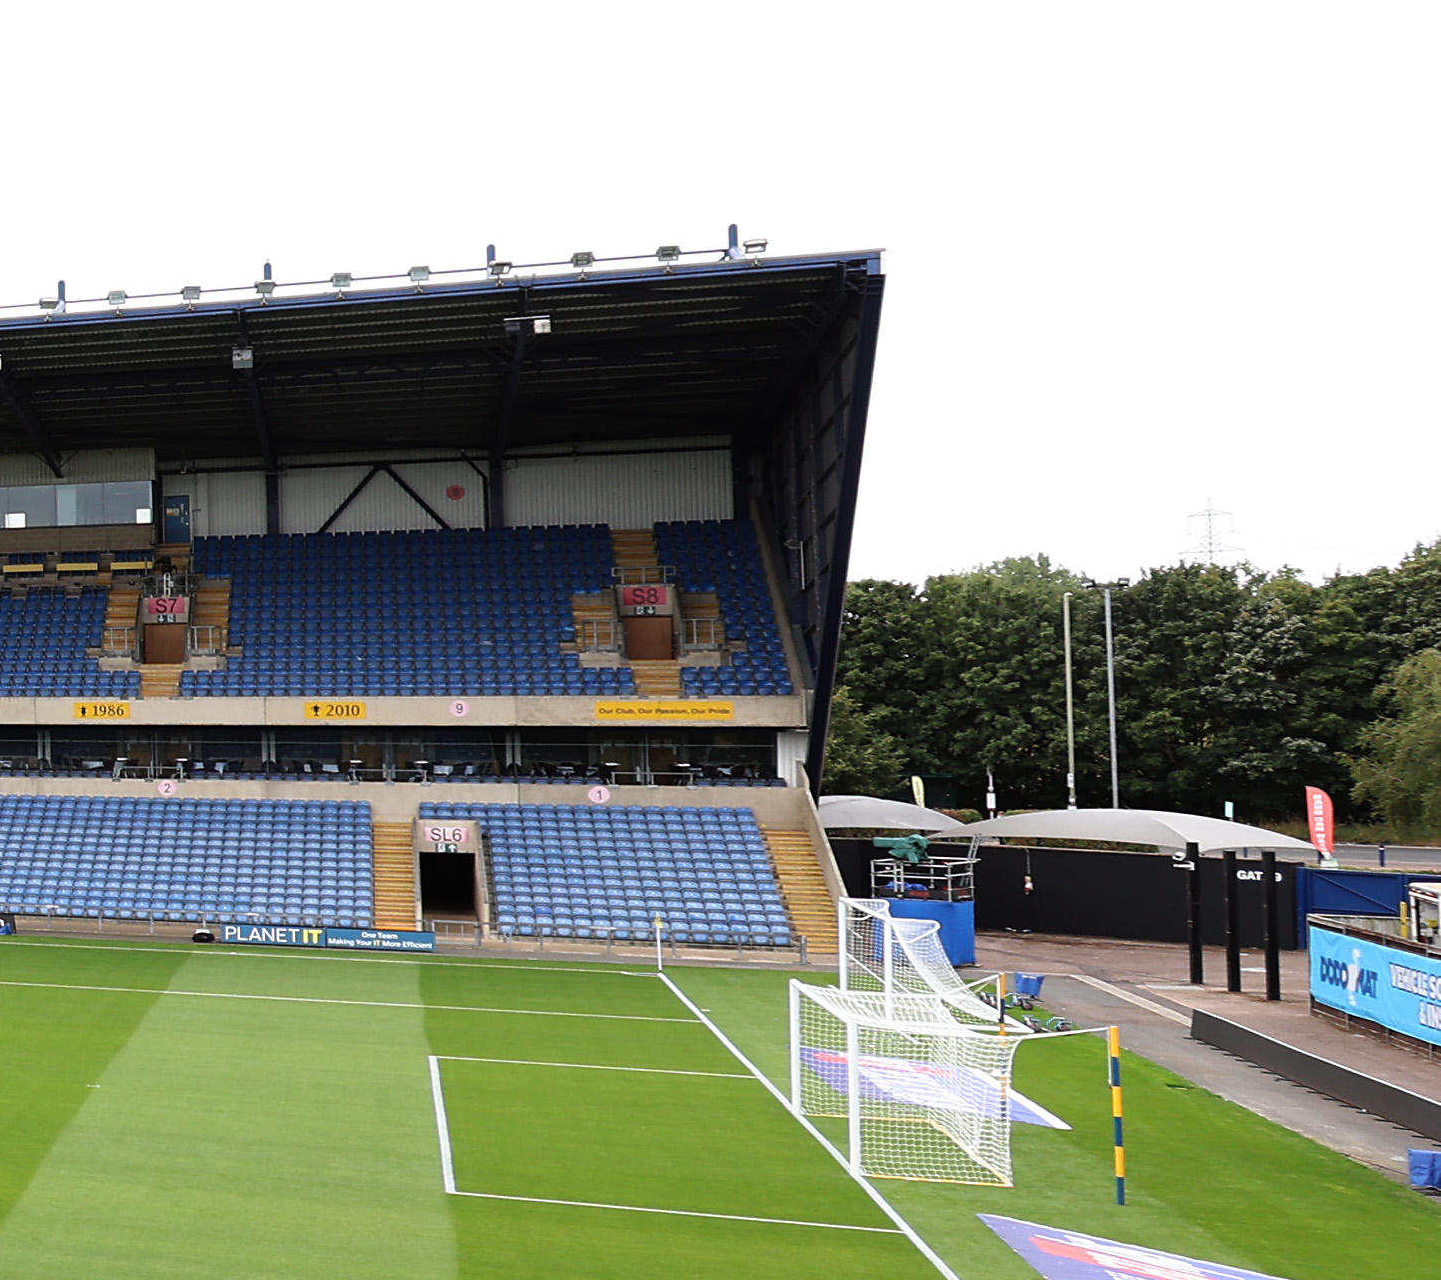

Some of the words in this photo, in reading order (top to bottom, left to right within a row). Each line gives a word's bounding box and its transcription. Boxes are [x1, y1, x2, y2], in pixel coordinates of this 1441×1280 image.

[632, 588, 658, 604] S8
[156, 598, 177, 614] S7
[92, 704, 125, 717] 1986
[325, 704, 361, 717] 2010
[455, 703, 464, 714] 9
[164, 782, 171, 792] 2
[430, 827, 462, 842] SL6
[1236, 869, 1264, 881] GAT
[224, 925, 300, 944] PLANET
[302, 929, 323, 944] IT
[361, 931, 376, 939] One
[328, 937, 355, 947] Making
[356, 938, 372, 946] Your
[382, 940, 402, 948] More
[403, 941, 434, 950] Efficient
[1320, 955, 1348, 990] DODO
[1355, 968, 1378, 999] MAT
[1389, 961, 1428, 997] VEHICLE
